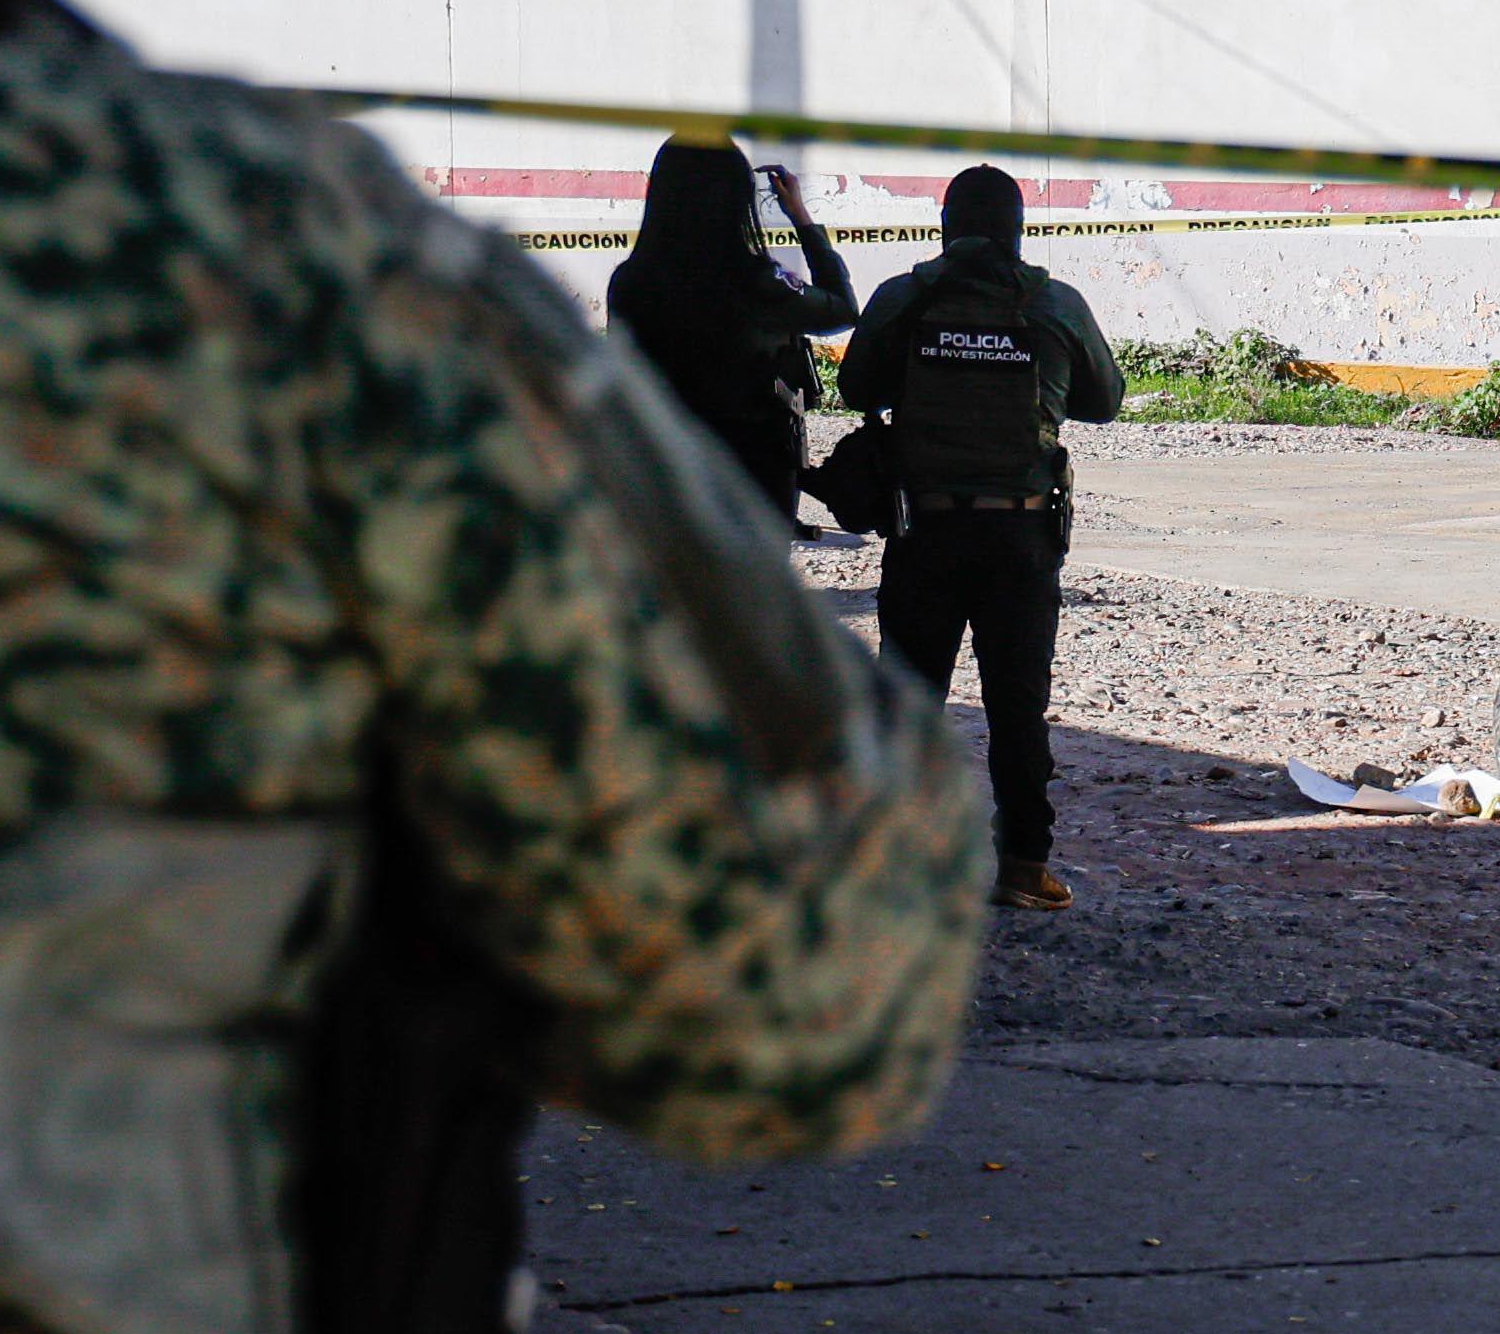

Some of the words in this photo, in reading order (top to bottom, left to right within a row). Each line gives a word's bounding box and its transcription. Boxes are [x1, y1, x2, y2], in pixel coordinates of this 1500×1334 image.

[517, 233, 629, 249] ECAUCIÓN
[836, 228, 942, 243] PRECAUC
[940, 332, 1015, 349] POLICIA
[921, 347, 938, 356] DE
[940, 348, 1031, 362] INVESTIGACIÓN
